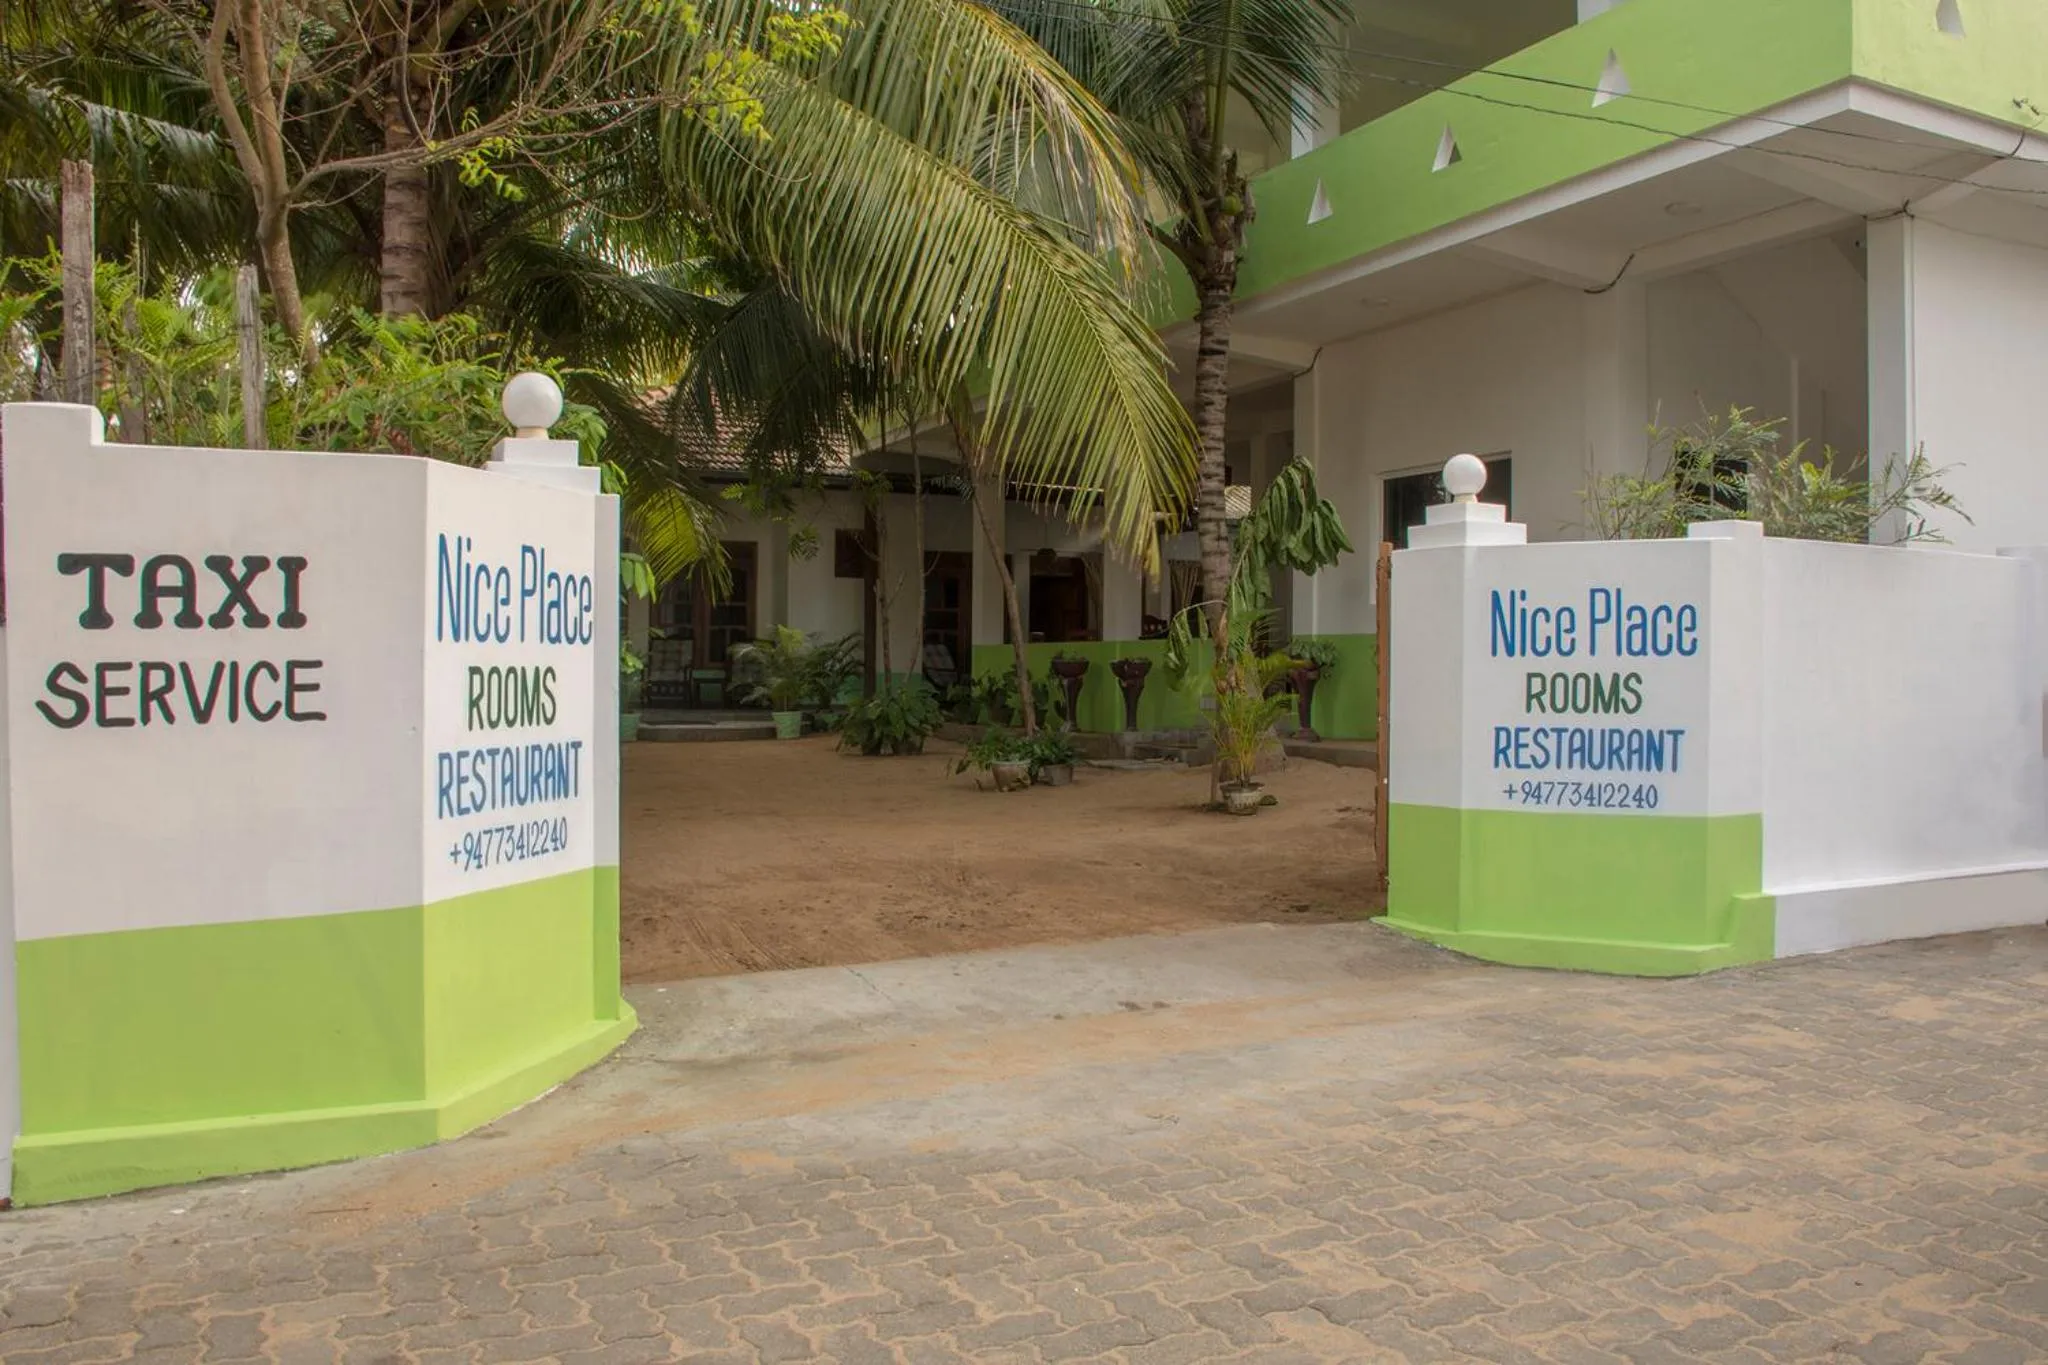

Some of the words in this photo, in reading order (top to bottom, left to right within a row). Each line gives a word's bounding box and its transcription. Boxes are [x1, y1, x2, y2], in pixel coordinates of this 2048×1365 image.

[57, 553, 308, 630] TAXI
[437, 532, 511, 644] Nice
[519, 544, 593, 645] Place
[1490, 588, 1577, 658] Nice
[1588, 587, 1698, 657] Place
[35, 659, 327, 728] SERVICE
[467, 665, 557, 732] ROOMS
[1525, 671, 1643, 715] ROOMS
[437, 740, 583, 820] RESTAURANT
[1493, 726, 1686, 773] RESTAURANT
[1502, 780, 1659, 809] +94773412240
[450, 816, 568, 872] +94773412240
